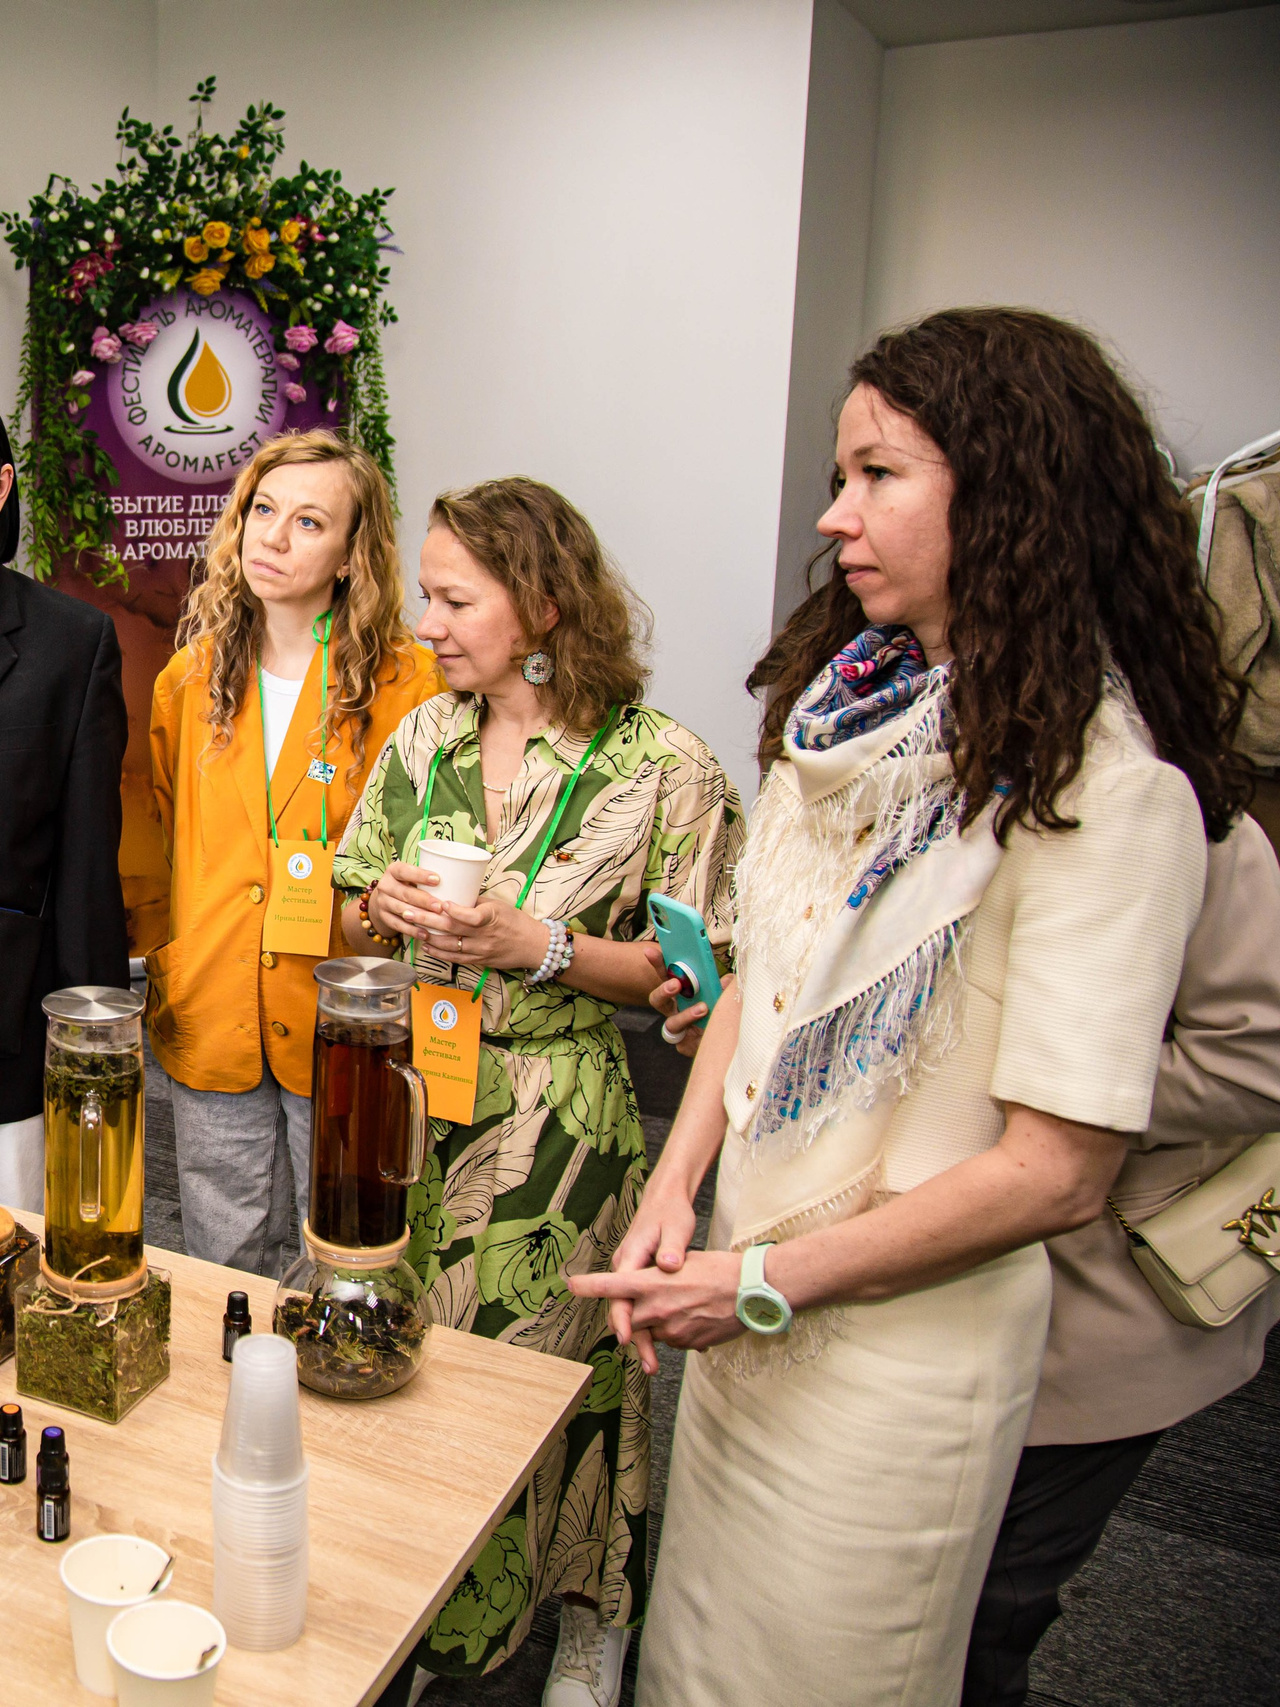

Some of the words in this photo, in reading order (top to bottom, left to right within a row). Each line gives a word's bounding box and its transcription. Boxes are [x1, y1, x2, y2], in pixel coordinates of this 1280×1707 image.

[121, 308, 177, 426] ФЕСТИЛЬ
[185, 299, 278, 425] АРОМАТЕРАПИИ
[104, 495, 184, 515] БЫТИЕ
[188, 494, 231, 517] ДЛЯ
[122, 541, 209, 561] АРОМАТ
[287, 885, 313, 895] Мастер
[281, 895, 317, 906] фестиваля
[429, 1035, 457, 1049] Мастер
[422, 1046, 461, 1062] фестиваля
